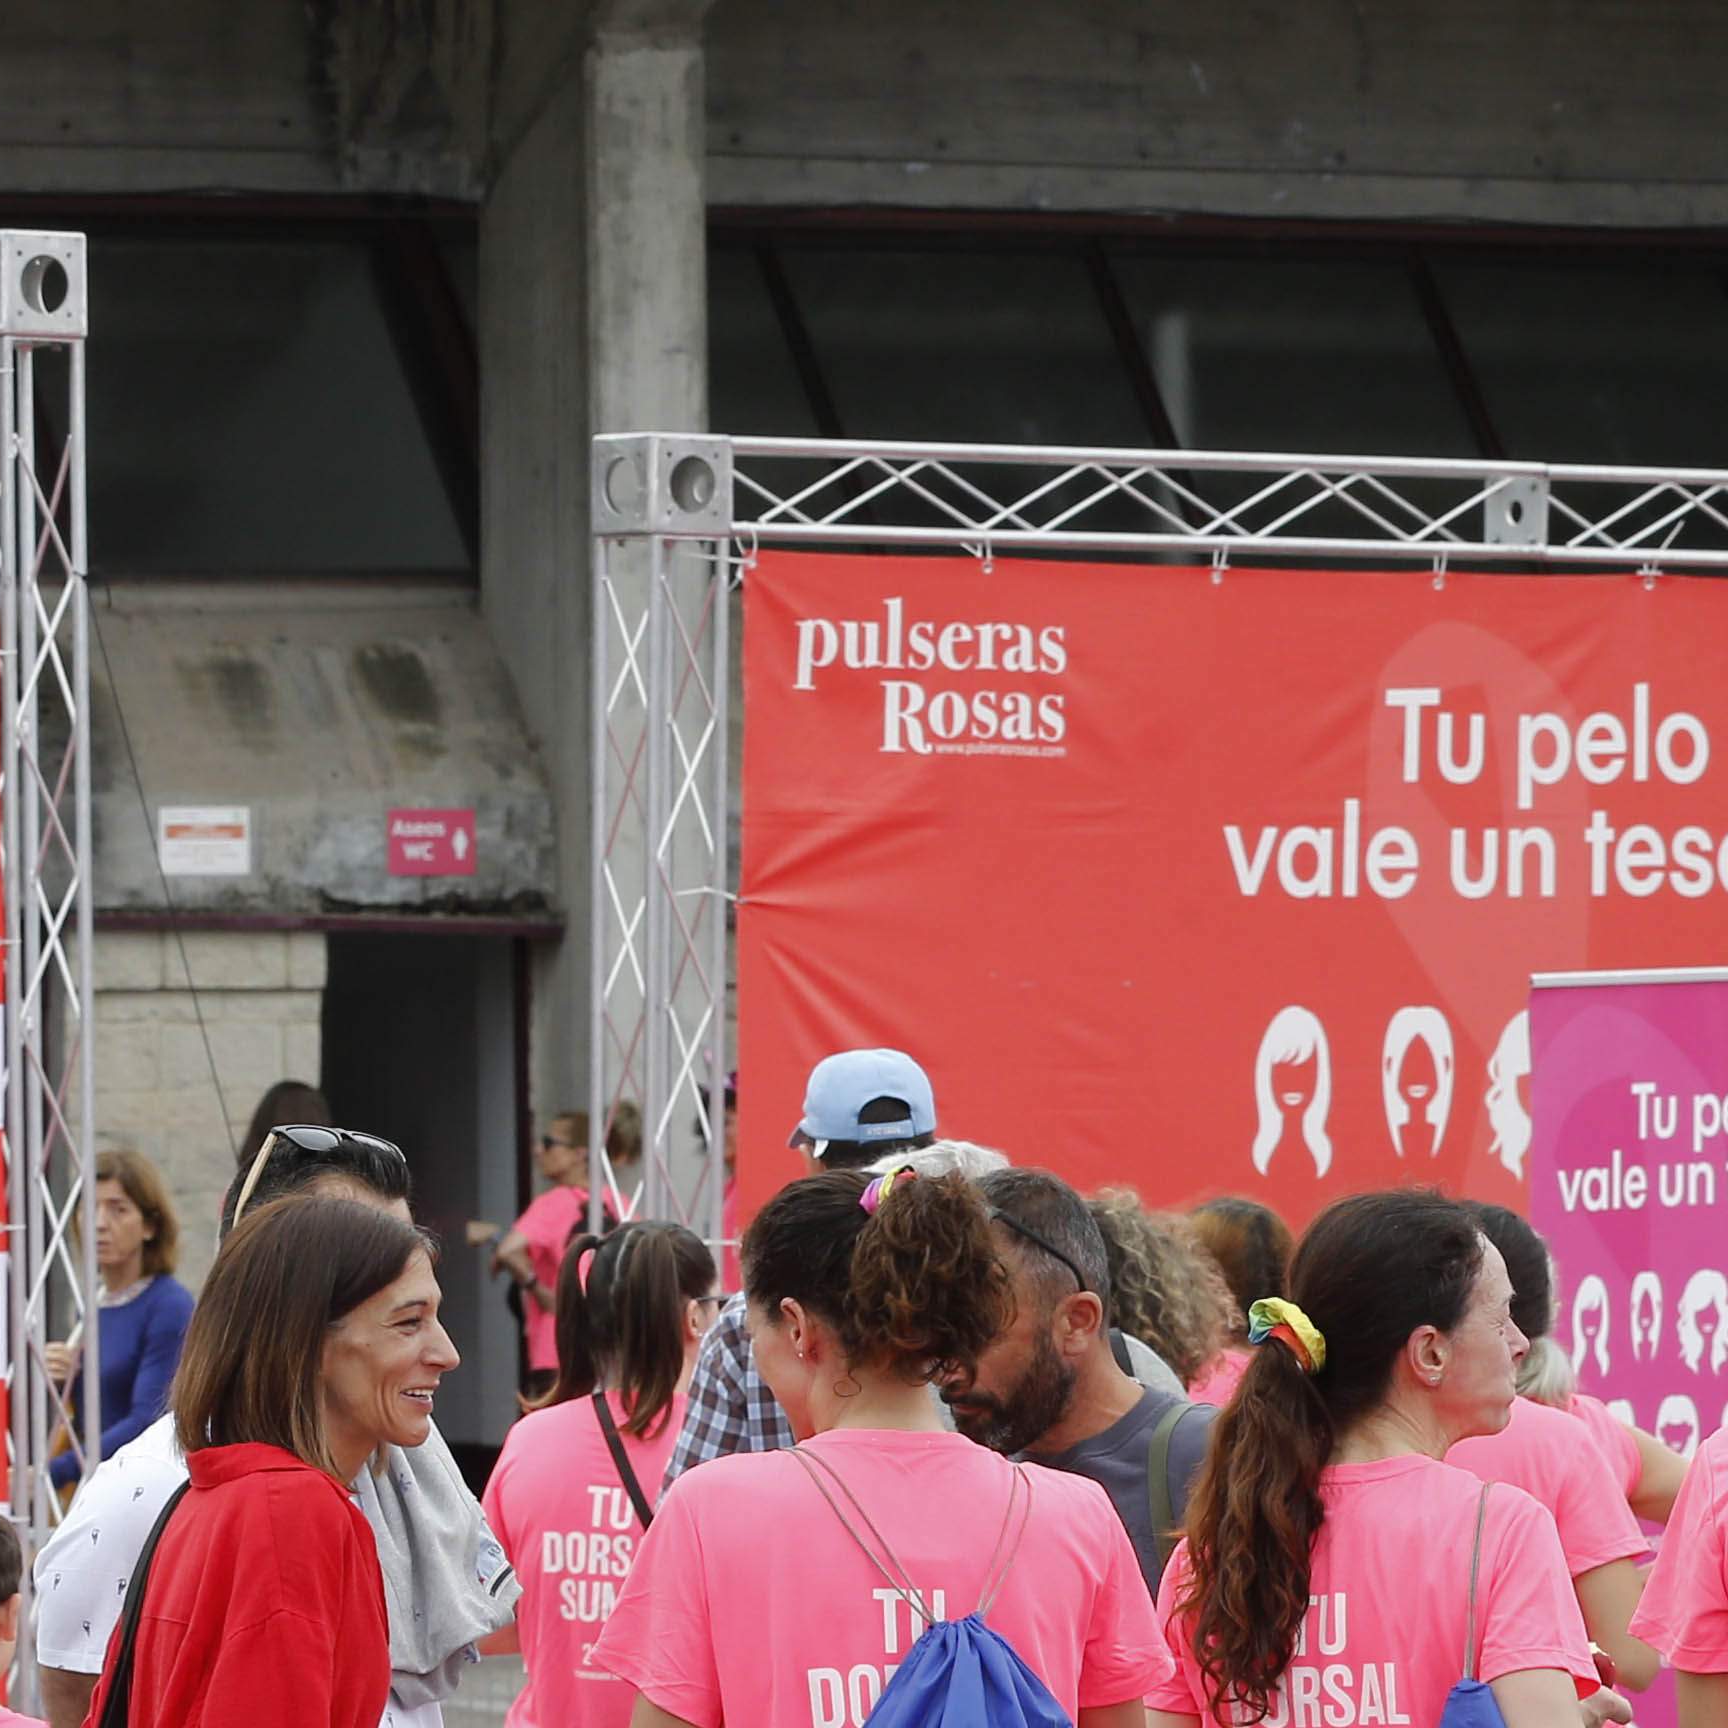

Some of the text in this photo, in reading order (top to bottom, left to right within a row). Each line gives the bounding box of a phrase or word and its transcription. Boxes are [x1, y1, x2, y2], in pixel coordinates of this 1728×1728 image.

[793, 597, 1067, 690] pulseras
[879, 680, 1067, 754] Rosas
[1384, 682, 1711, 810] Tu pelo
[1223, 797, 1418, 899] vale
[1450, 826, 1556, 899] un
[1631, 1082, 1676, 1141] Tu
[1558, 1150, 1652, 1212] vale
[1659, 1160, 1715, 1208] un
[587, 1485, 634, 1530] TU
[543, 1531, 637, 1577] DORS
